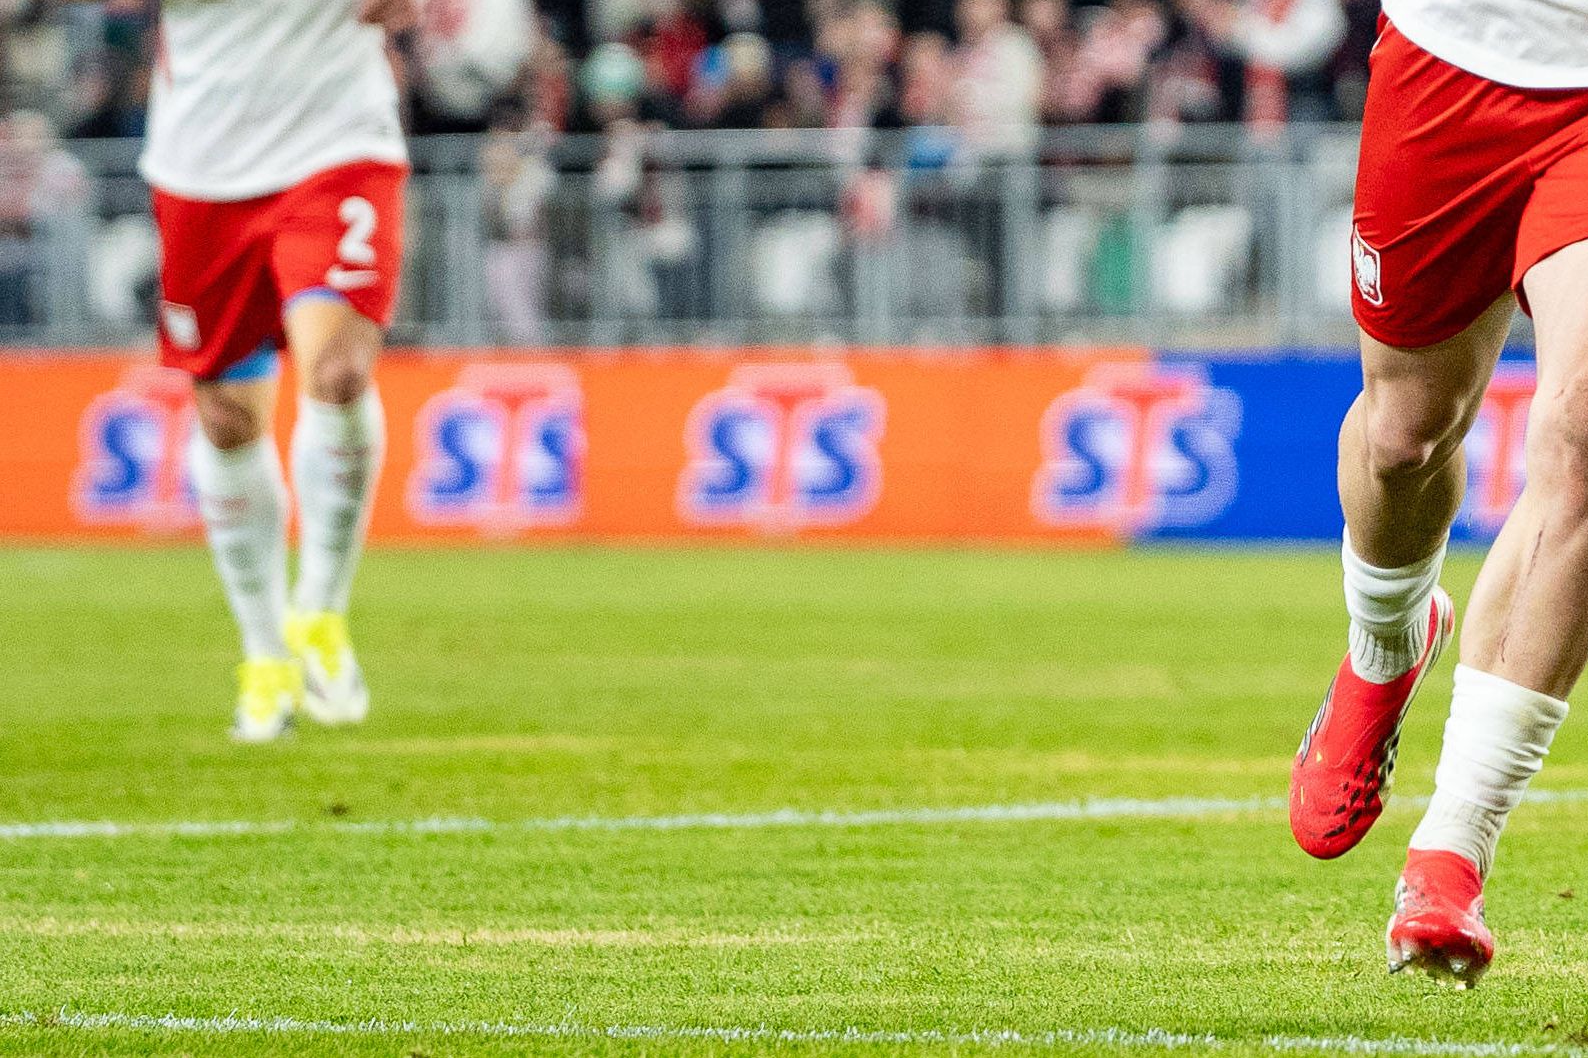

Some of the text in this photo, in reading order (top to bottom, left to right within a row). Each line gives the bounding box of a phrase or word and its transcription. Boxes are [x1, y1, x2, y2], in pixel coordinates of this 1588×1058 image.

[337, 194, 378, 265] 2
[404, 363, 588, 534] STS
[674, 363, 888, 537] STS
[1030, 362, 1243, 534] STS
